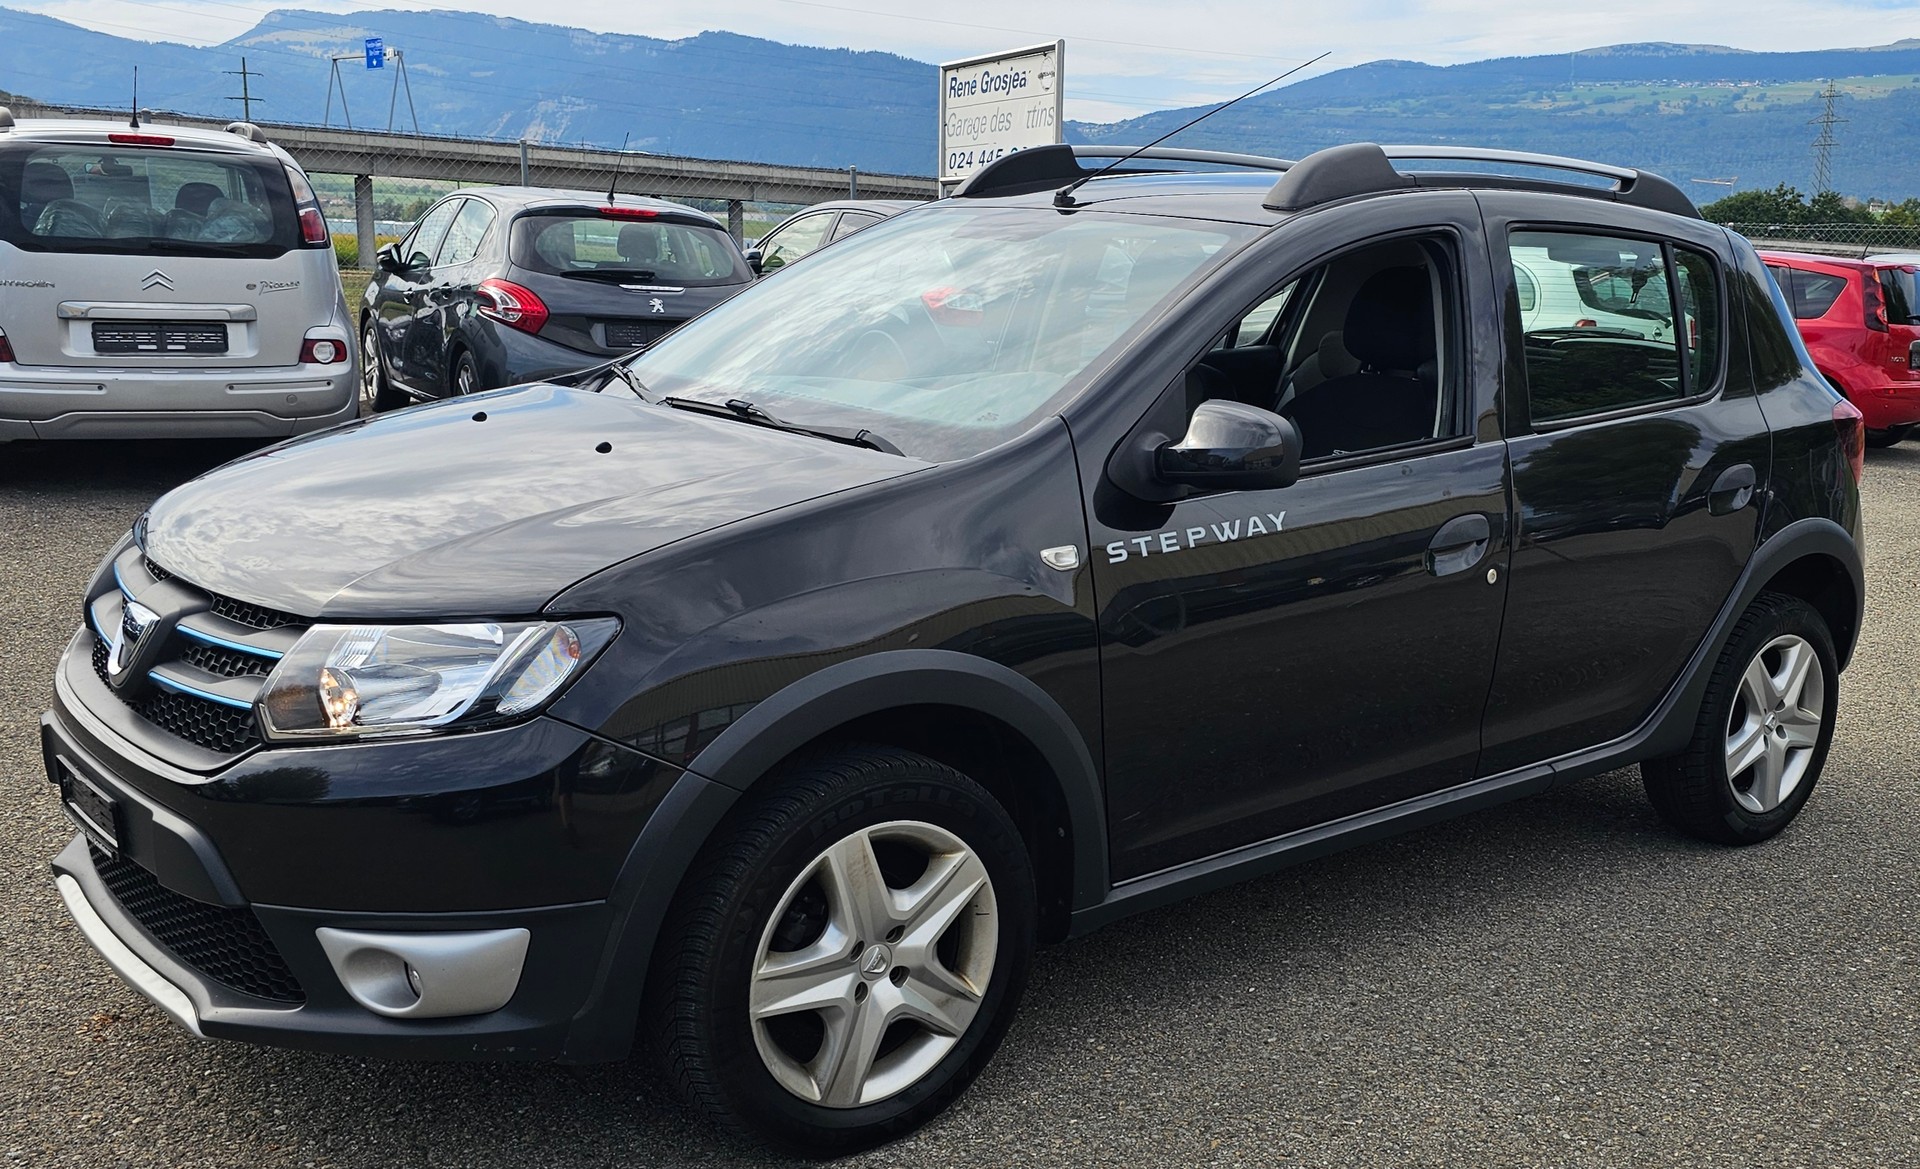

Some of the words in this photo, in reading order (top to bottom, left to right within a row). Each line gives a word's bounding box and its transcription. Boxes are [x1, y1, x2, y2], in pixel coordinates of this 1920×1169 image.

[948, 73, 977, 99] René
[980, 66, 1031, 96] Grosjea
[946, 112, 988, 141] Garage
[990, 106, 1013, 133] des
[949, 151, 974, 170] 024
[0, 279, 55, 289] ITROËN
[1106, 510, 1287, 564] STEPWAY
